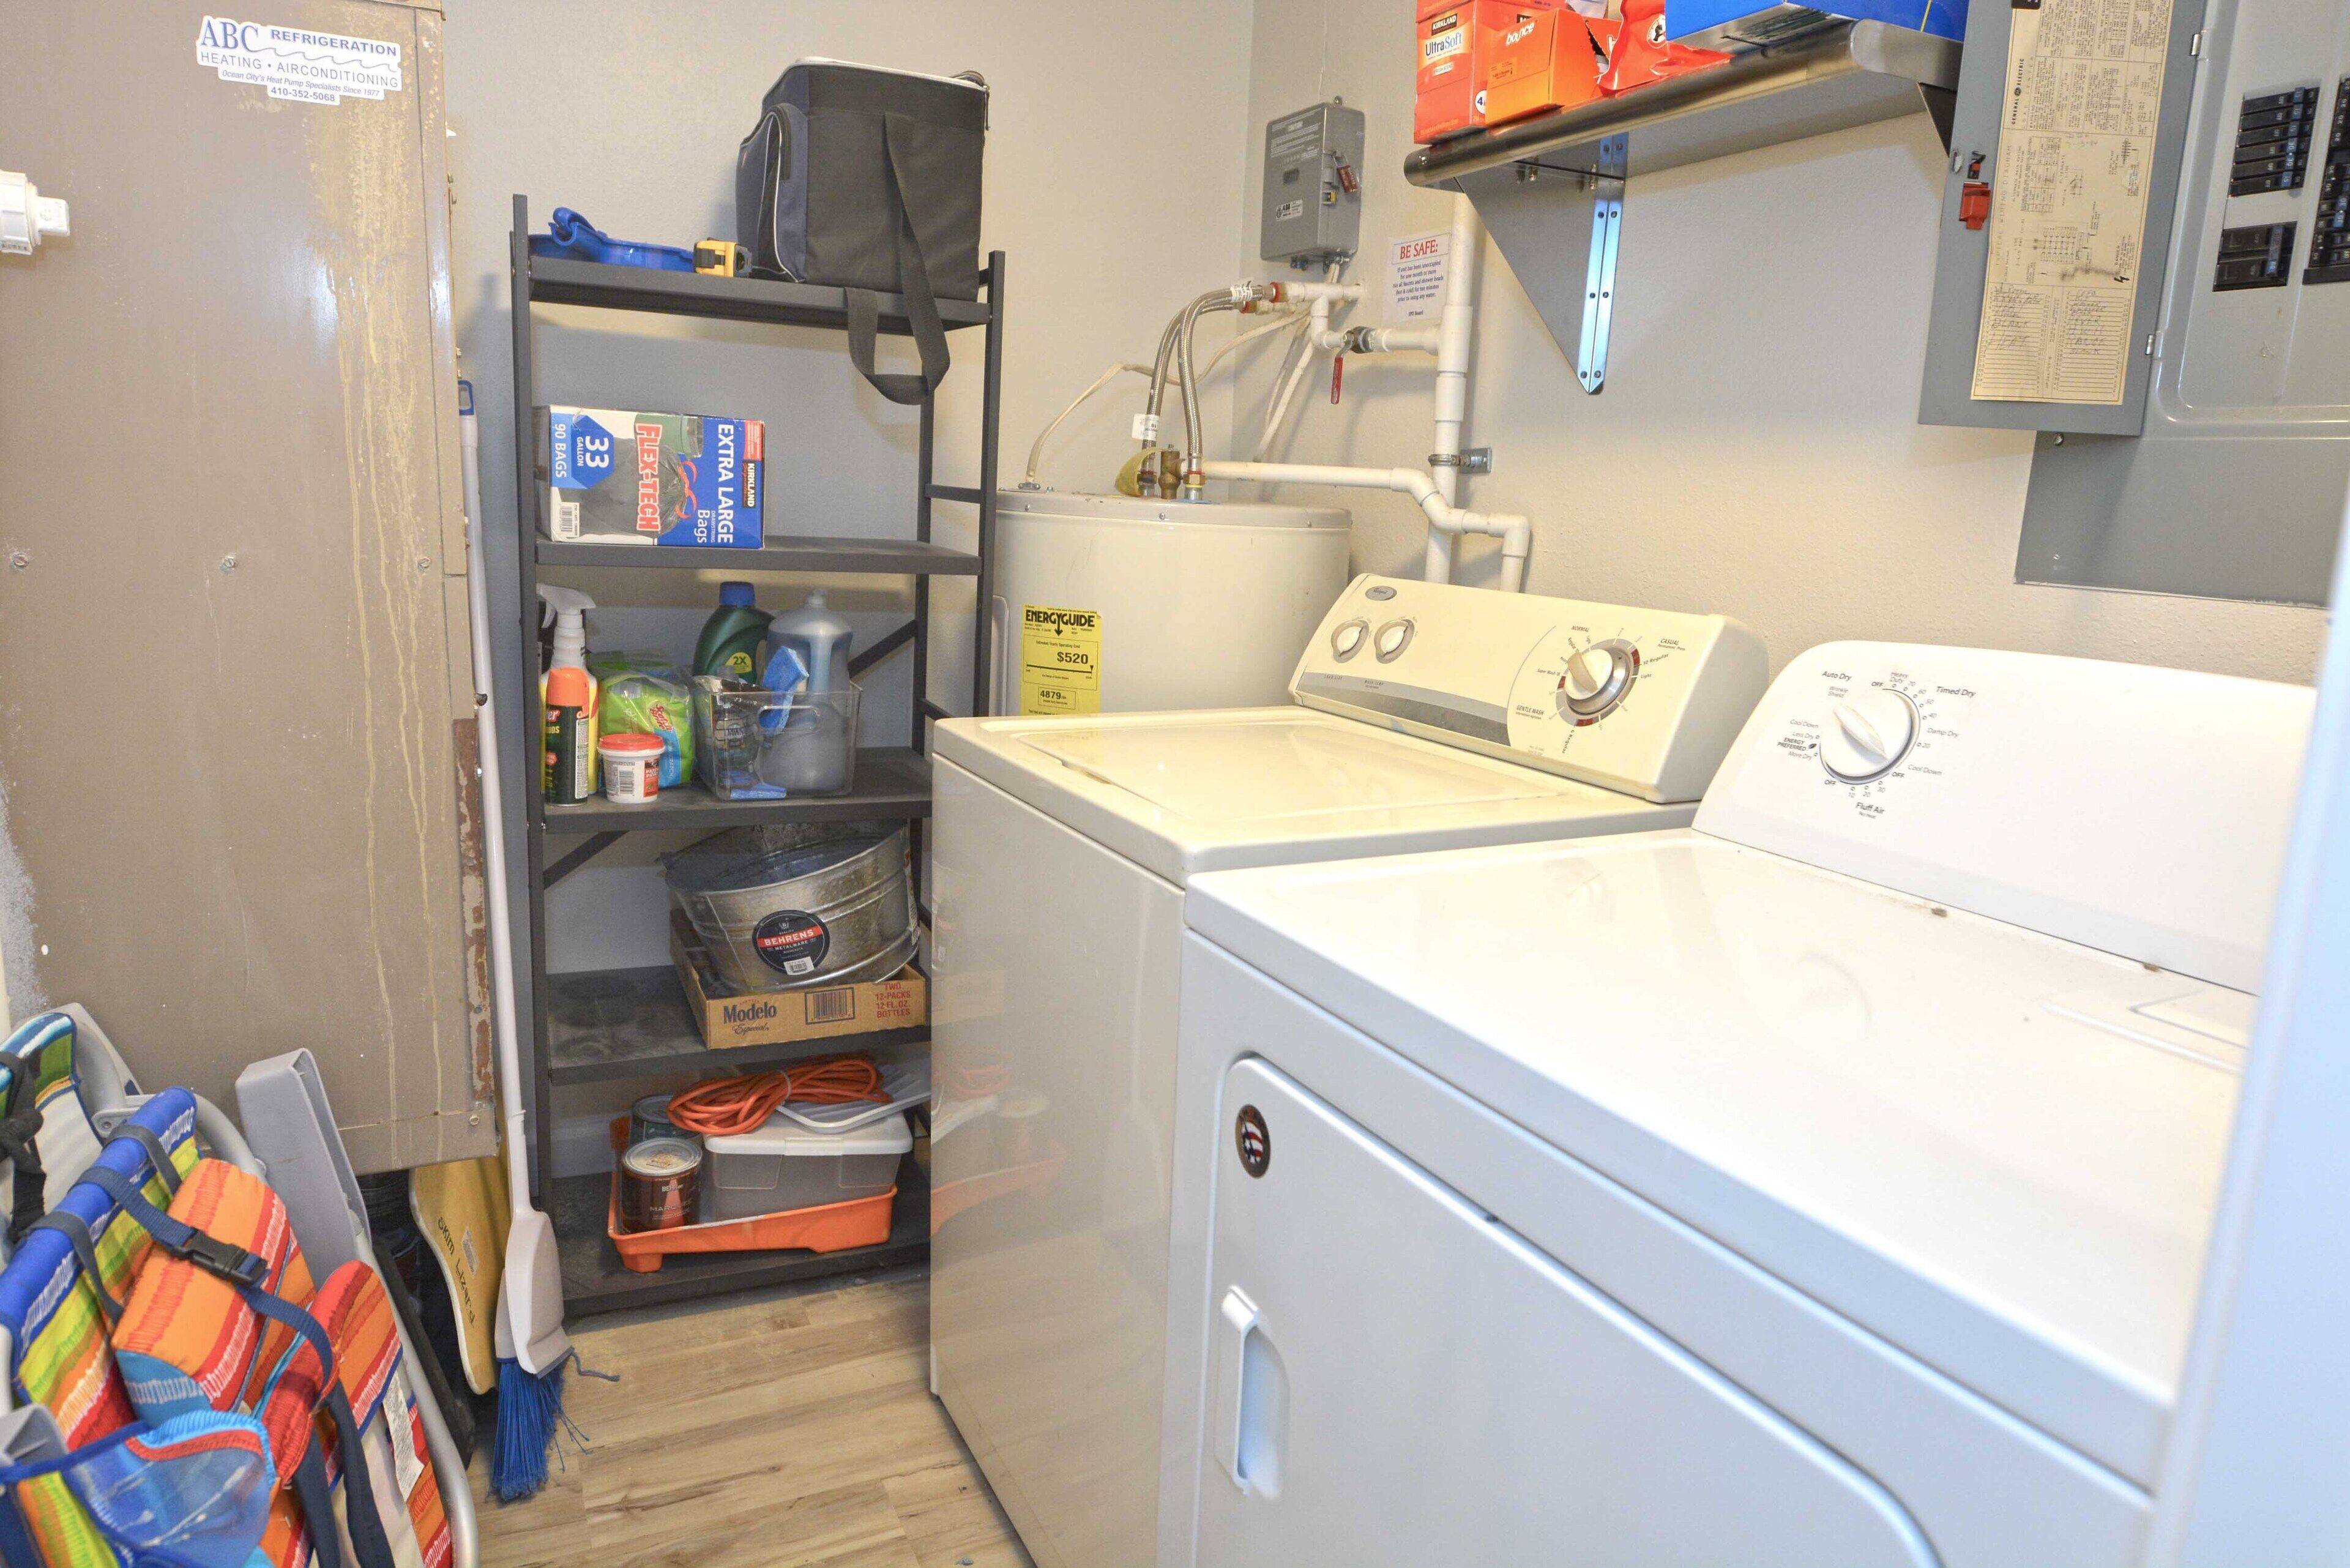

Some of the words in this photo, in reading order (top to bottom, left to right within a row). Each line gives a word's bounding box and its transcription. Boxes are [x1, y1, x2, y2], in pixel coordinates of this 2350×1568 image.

[1433, 15, 1457, 30] KIRKLAND
[201, 20, 258, 52] ABC
[270, 29, 397, 56] REFRIGERATION
[1505, 22, 1535, 47] bounce
[1425, 32, 1461, 56] UltraSoft
[201, 51, 262, 69] HEATING
[277, 62, 398, 88] AIRCONDITIONING
[222, 70, 244, 78] Ocean
[246, 72, 264, 82] City's
[285, 78, 304, 87] Pump
[305, 81, 341, 92] Specialists
[271, 87, 335, 102] 410-352-5068
[2340, 99, 2348, 108] 20
[2335, 133, 2341, 141] 20
[1400, 245, 1411, 259] BE
[1414, 239, 1438, 258] SAFE:
[554, 424, 567, 438] 90
[576, 436, 584, 466] GALLON
[585, 435, 610, 468] 33
[718, 424, 734, 482] EXTRA
[554, 443, 567, 477] BAGS
[717, 487, 734, 543] LARGE
[694, 510, 710, 543] Bags
[1026, 609, 1095, 628] ENERGYGUIDE
[733, 656, 747, 665] 2X
[1057, 651, 1088, 665] $520
[1650, 654, 1669, 663] Regular
[1040, 690, 1061, 700] 4879
[1936, 685, 1961, 695] Timed
[1961, 689, 1976, 698] Dry
[1927, 727, 1947, 736] Damp
[1562, 734, 1573, 753] Regular
[1777, 742, 1807, 751] PREFERRED
[1908, 764, 1923, 773] Cool
[1923, 767, 1942, 776] Down
[1856, 802, 1873, 812] Fluff
[764, 929, 814, 946] BEHRENS
[775, 941, 808, 950] METALWARE
[875, 991, 911, 1000] 12-PACKS
[723, 1002, 777, 1024] Modelo
[877, 1010, 910, 1018] BOTTLES
[732, 1022, 769, 1036] Especial
[438, 1216, 455, 1256] Skim
[457, 1258, 476, 1329] Lizard
